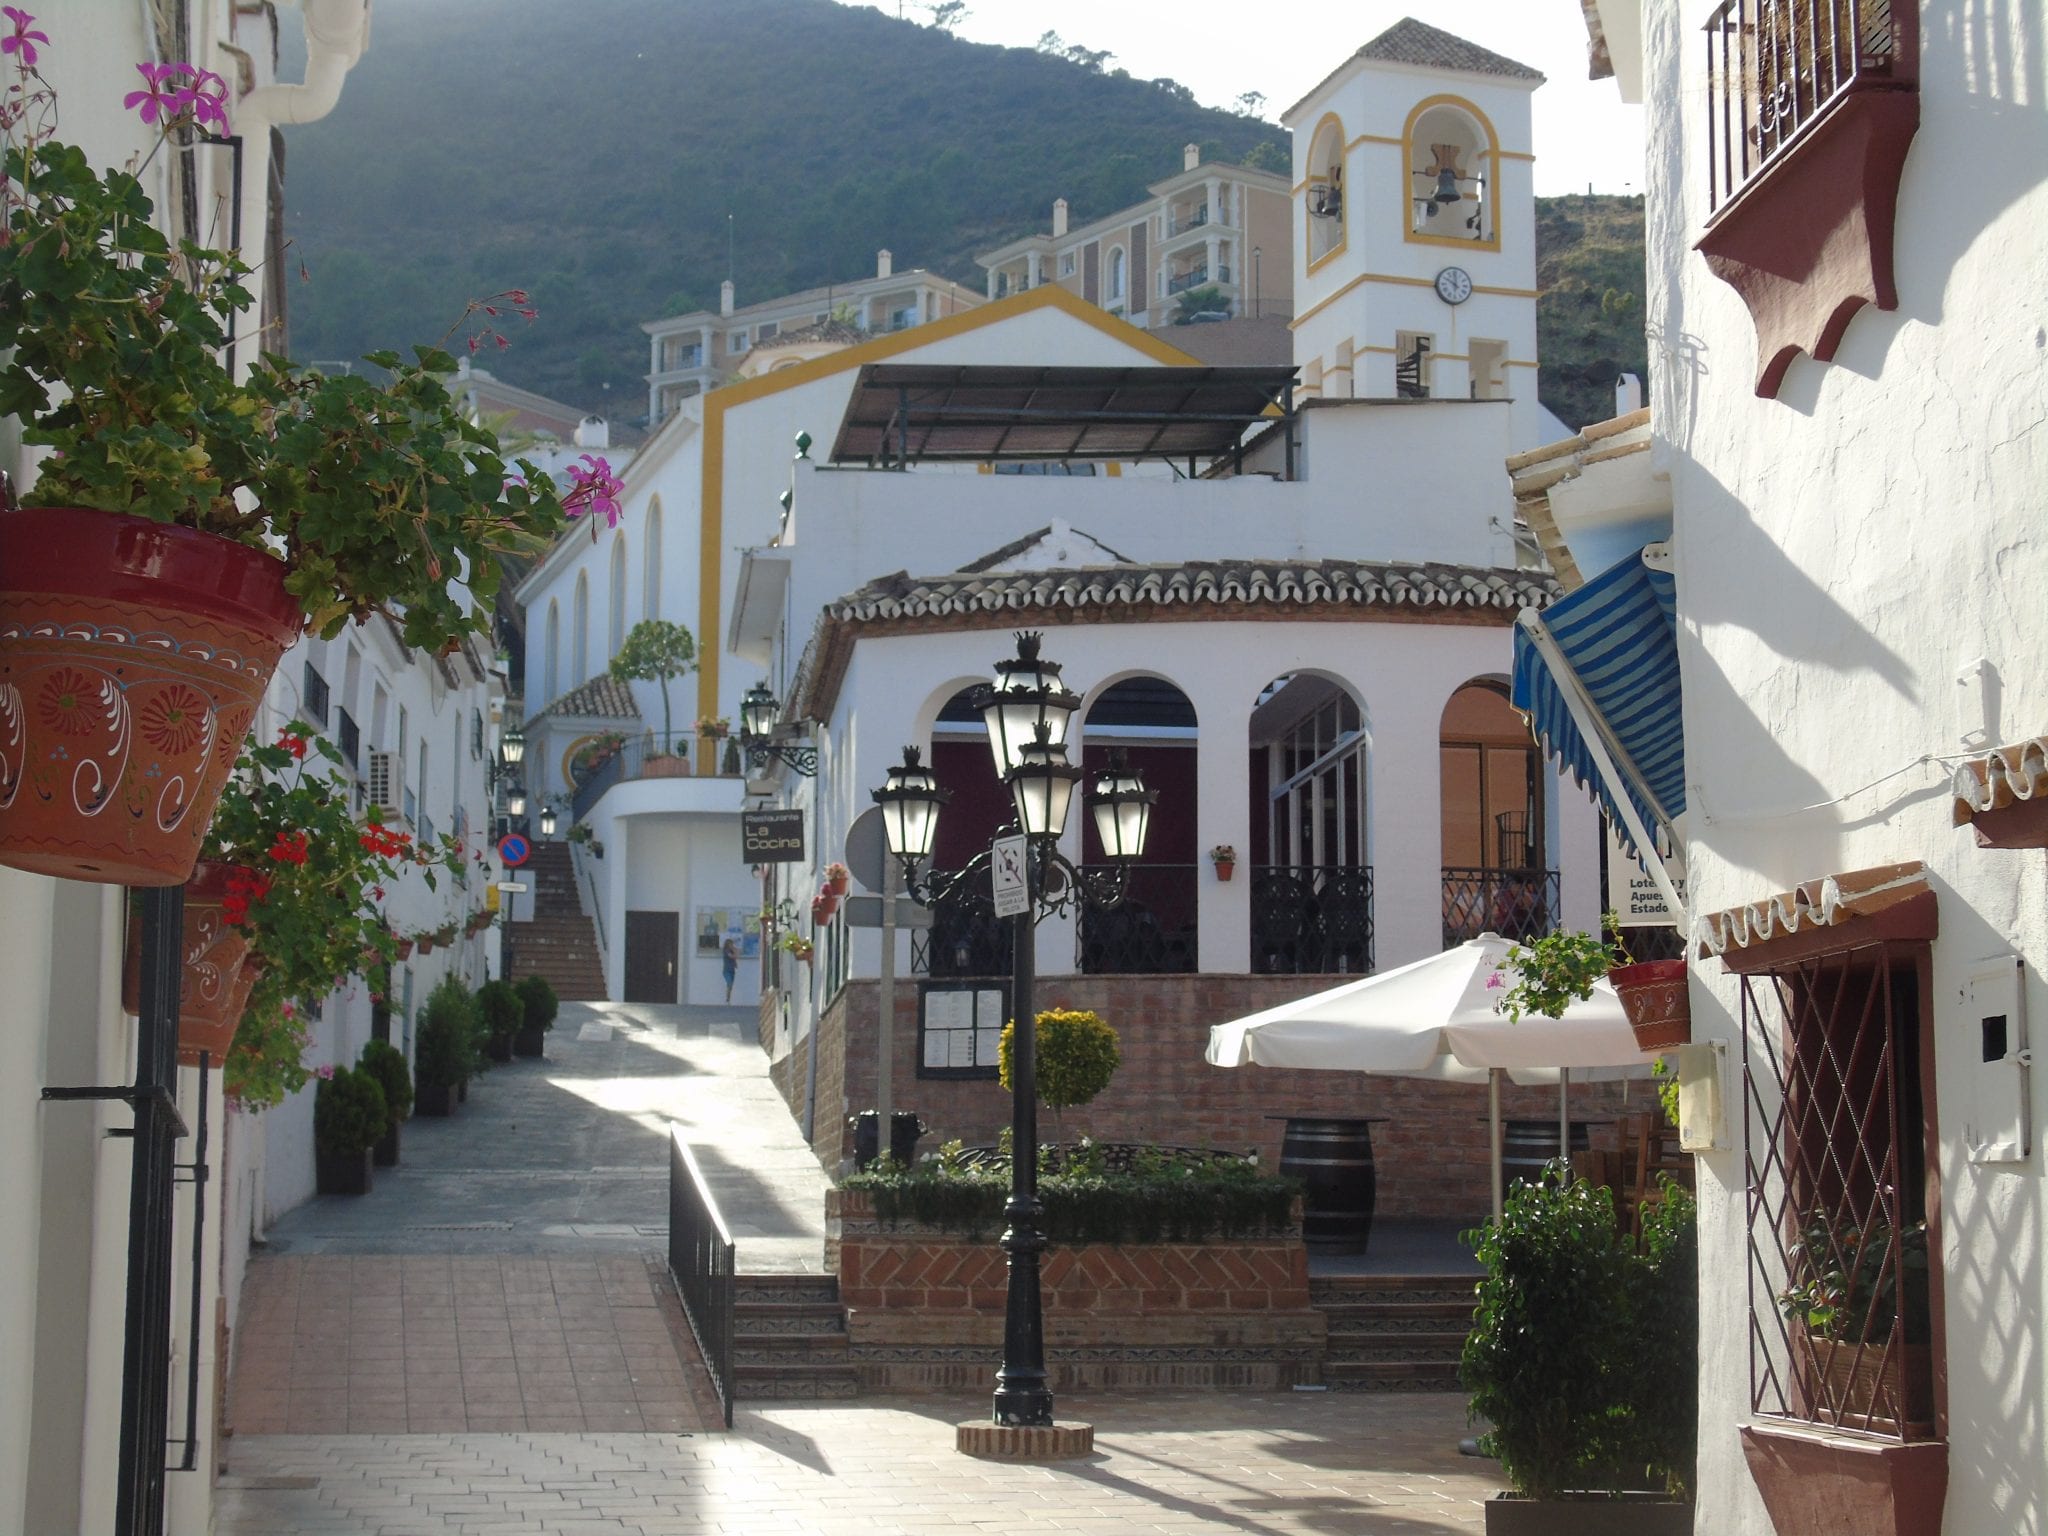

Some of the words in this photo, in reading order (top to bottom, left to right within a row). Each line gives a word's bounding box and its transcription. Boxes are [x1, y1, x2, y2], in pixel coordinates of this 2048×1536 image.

[746, 814, 800, 823] Restaurante
[746, 826, 769, 837] La
[746, 838, 801, 850] Cocina
[1630, 879, 1675, 889] Lotes
[1678, 879, 1684, 888] y
[1631, 891, 1682, 903] Apuess
[1630, 903, 1669, 914] Estado
